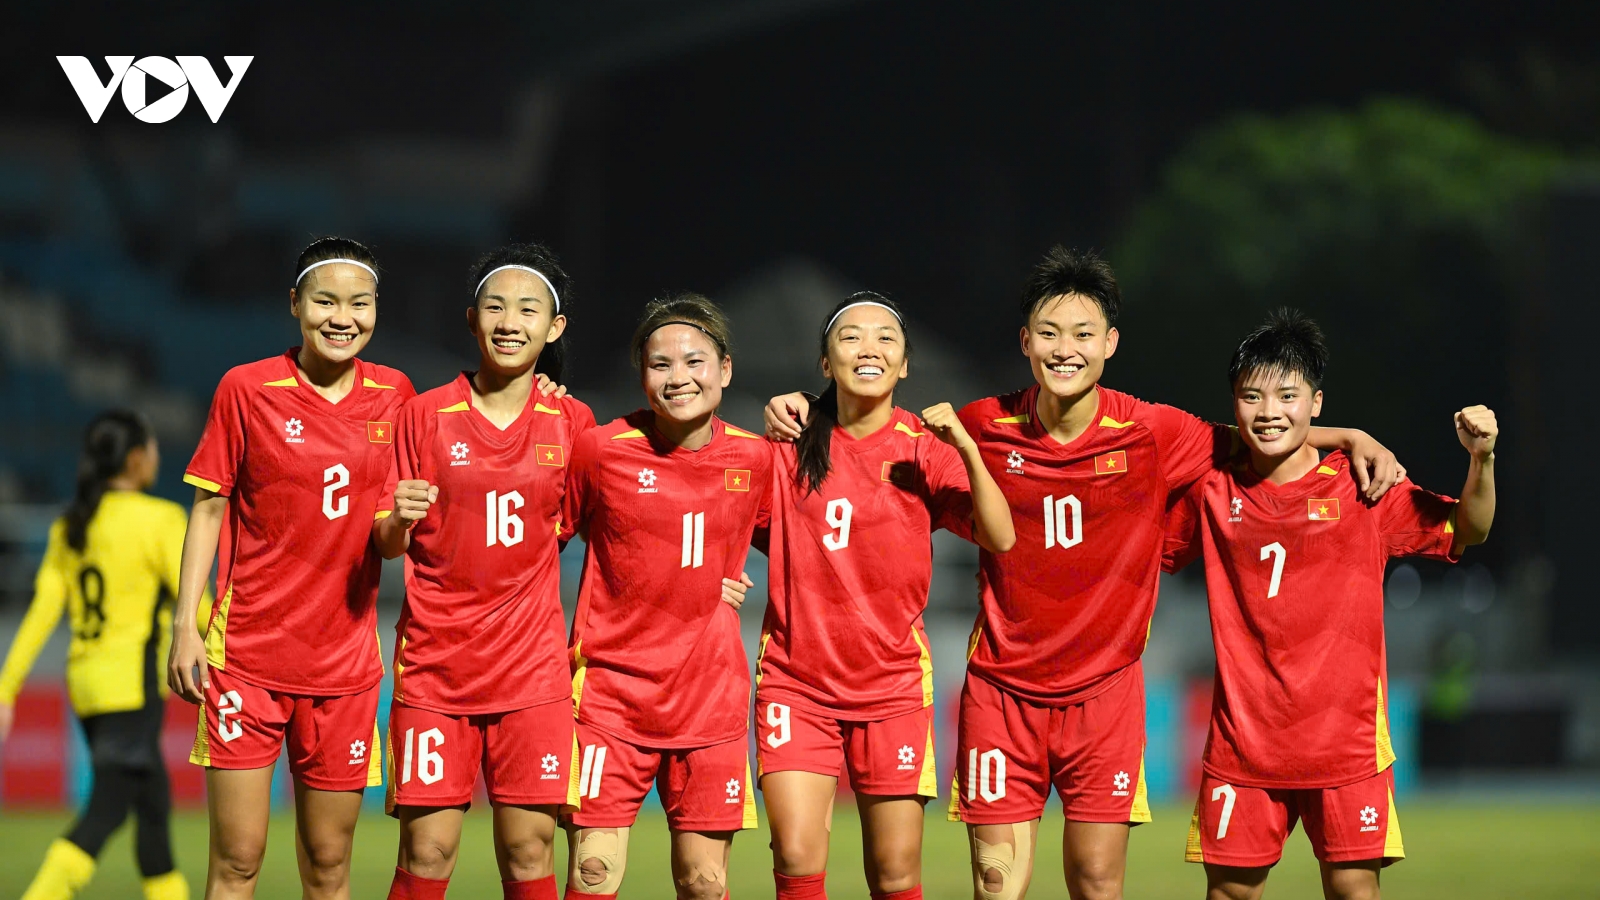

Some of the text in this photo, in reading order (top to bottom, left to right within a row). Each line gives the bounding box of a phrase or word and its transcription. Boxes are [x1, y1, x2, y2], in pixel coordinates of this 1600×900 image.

[323, 463, 349, 520] 2
[486, 490, 525, 548] 16
[682, 512, 705, 568] 11
[823, 498, 853, 551] 9
[1044, 495, 1083, 550] 10
[1260, 542, 1287, 598] 7
[218, 690, 243, 742] 2
[767, 702, 792, 748] 9
[402, 728, 445, 785] 16
[579, 743, 608, 798] 11
[968, 748, 1007, 804] 10
[1212, 784, 1237, 840] 7
